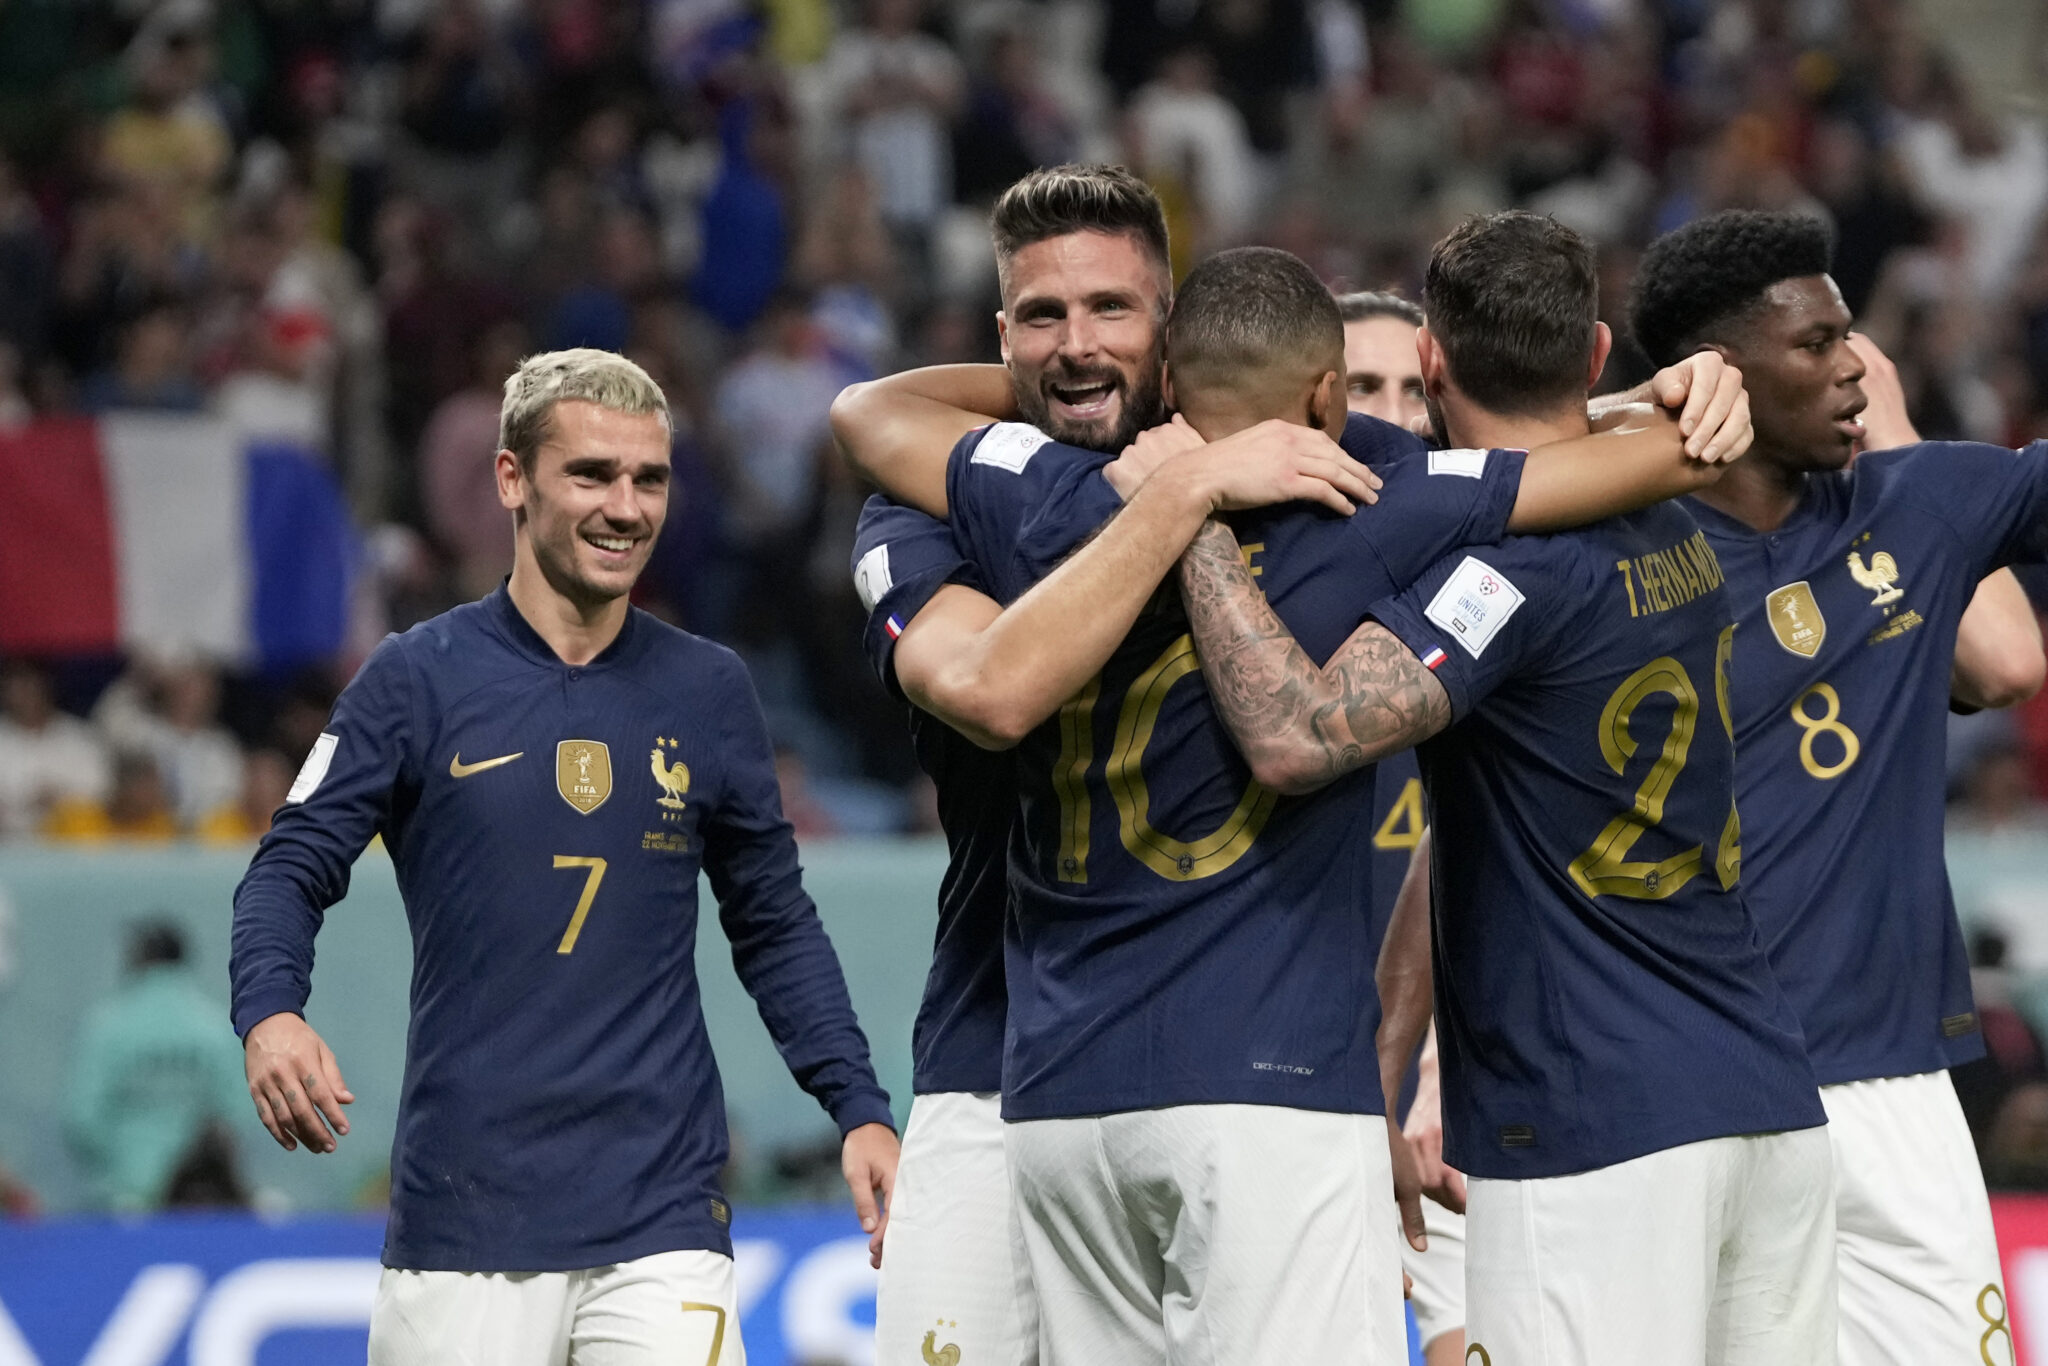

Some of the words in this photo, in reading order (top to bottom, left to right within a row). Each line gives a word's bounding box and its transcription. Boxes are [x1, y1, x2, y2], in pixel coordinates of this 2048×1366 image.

[1457, 596, 1486, 622] UNITES
[1052, 633, 1280, 884] 10
[1791, 682, 1860, 779] 8
[574, 785, 597, 794] FIFA
[1373, 777, 1424, 853] 4
[553, 855, 607, 953] 7
[681, 1301, 726, 1366] 7
[1976, 1283, 2014, 1366] 8
